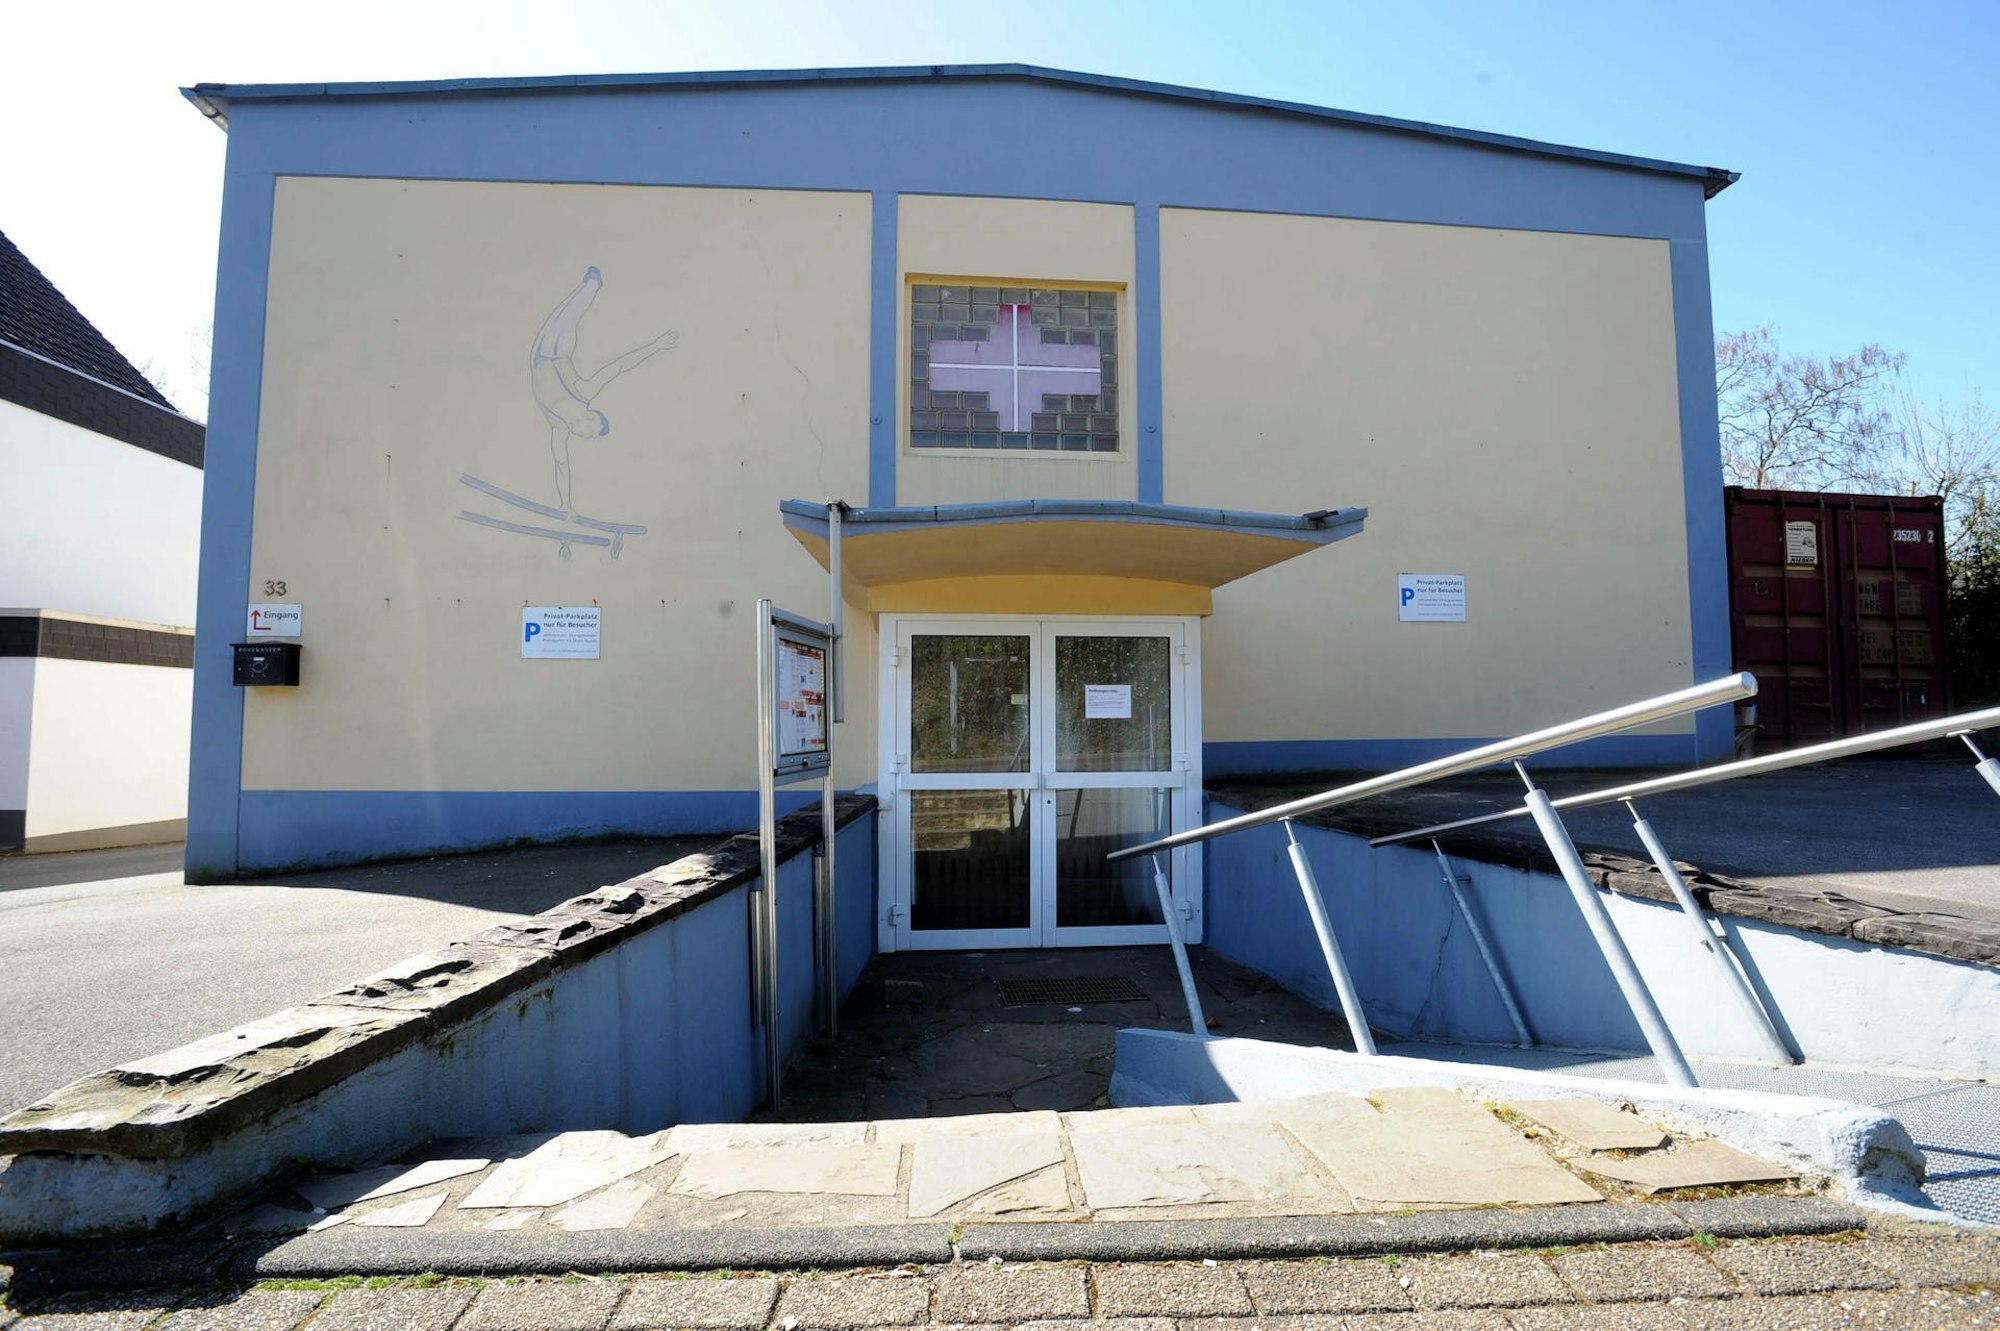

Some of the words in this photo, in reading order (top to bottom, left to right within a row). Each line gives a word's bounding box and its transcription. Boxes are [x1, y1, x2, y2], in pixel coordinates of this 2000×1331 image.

[1926, 529, 1935, 543] 2
[263, 580, 288, 597] 33
[1400, 587, 1415, 606] P
[263, 610, 299, 620] Eingang
[543, 613, 598, 621] Privat-Parkplatz
[524, 622, 541, 643] P
